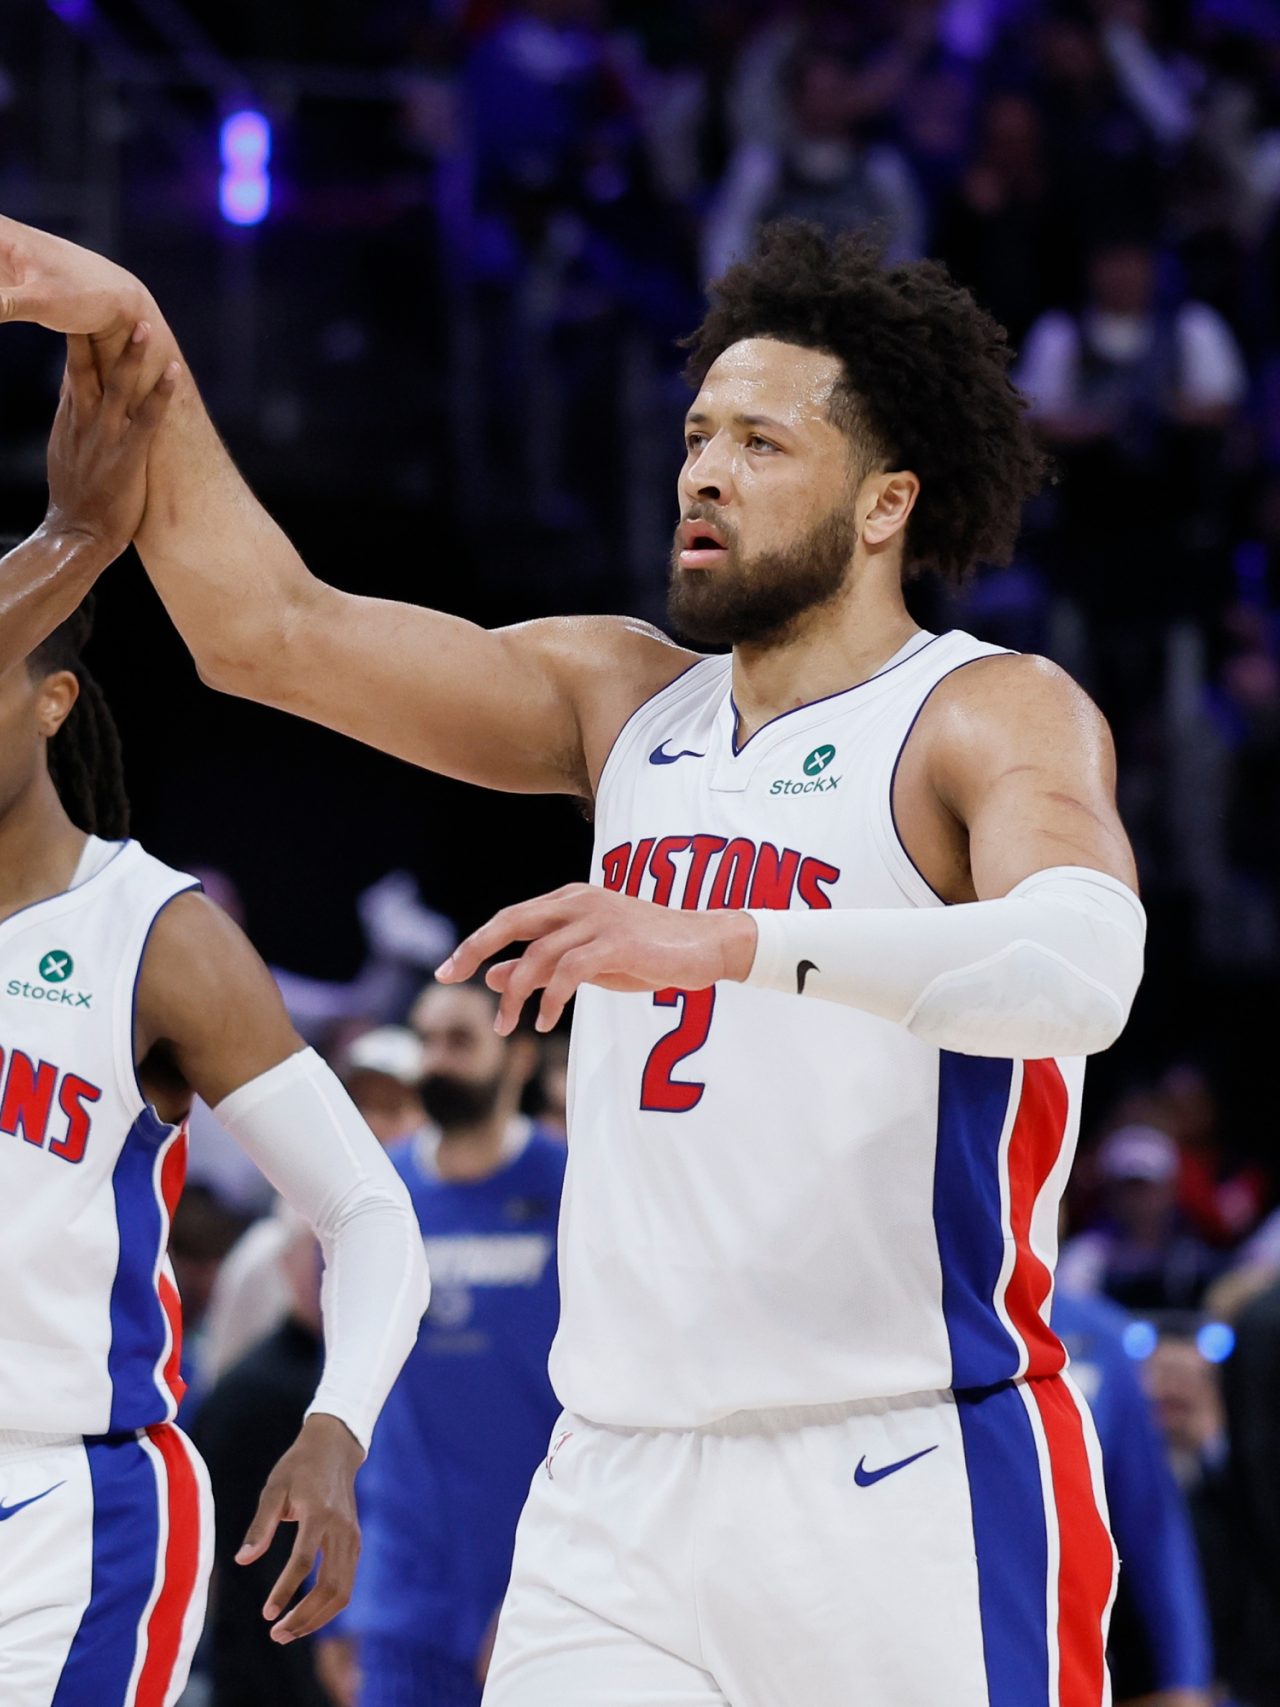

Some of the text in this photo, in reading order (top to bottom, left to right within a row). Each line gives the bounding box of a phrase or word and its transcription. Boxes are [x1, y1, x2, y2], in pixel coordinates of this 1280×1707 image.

[769, 775, 843, 796] StockX
[602, 833, 841, 910] PISTONS
[6, 980, 93, 1009] StockX
[639, 983, 716, 1113] 2
